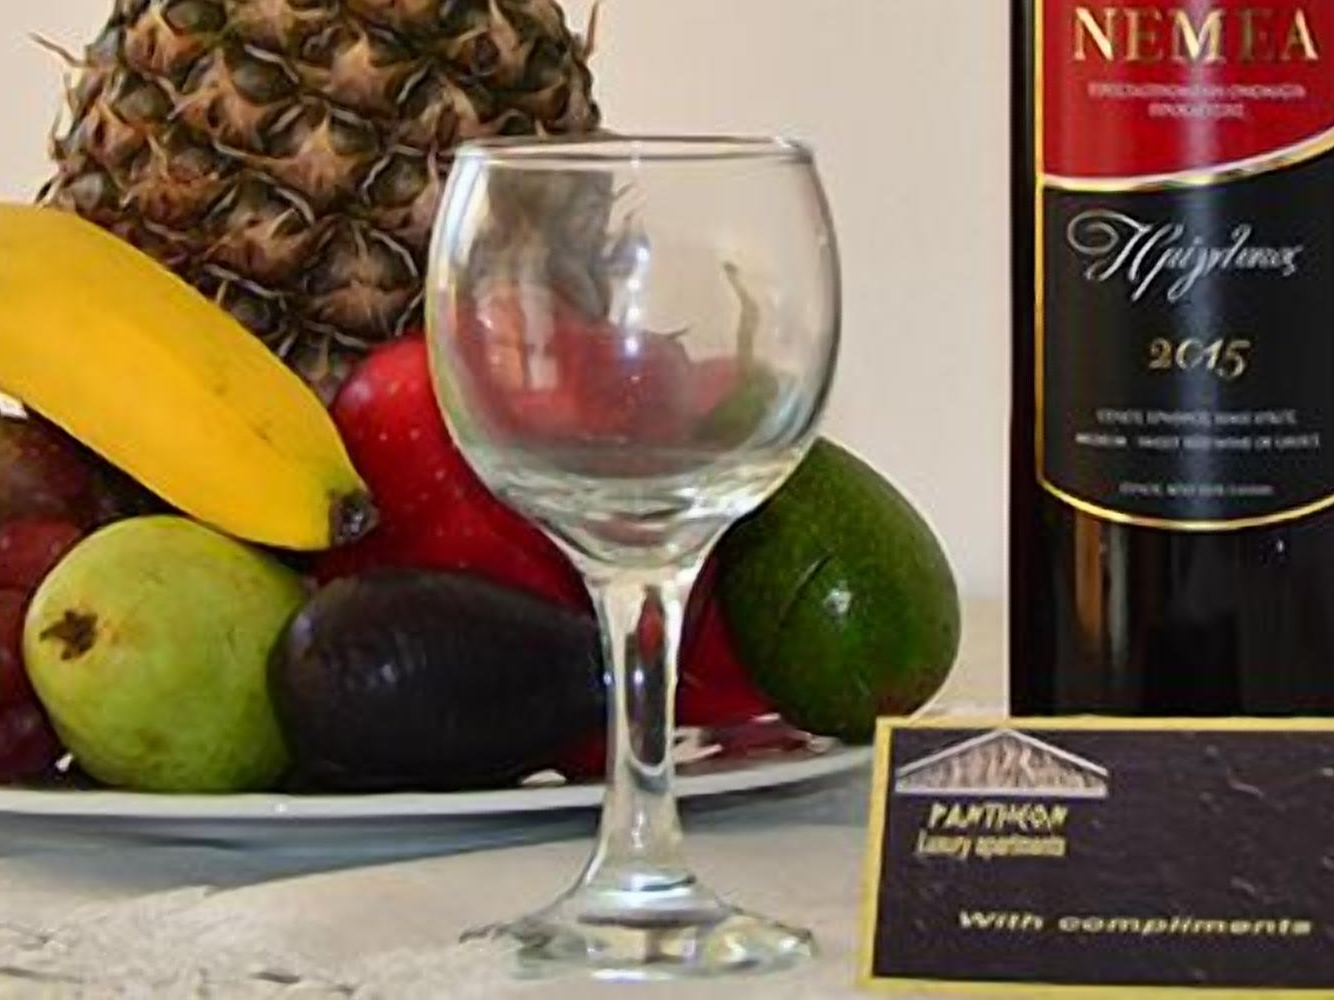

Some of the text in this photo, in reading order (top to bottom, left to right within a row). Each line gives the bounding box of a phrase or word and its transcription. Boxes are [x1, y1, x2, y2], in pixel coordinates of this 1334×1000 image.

[1071, 6, 1319, 62] NEMEA
[1147, 337, 1251, 380] 2015
[959, 910, 1313, 936] With compliments
